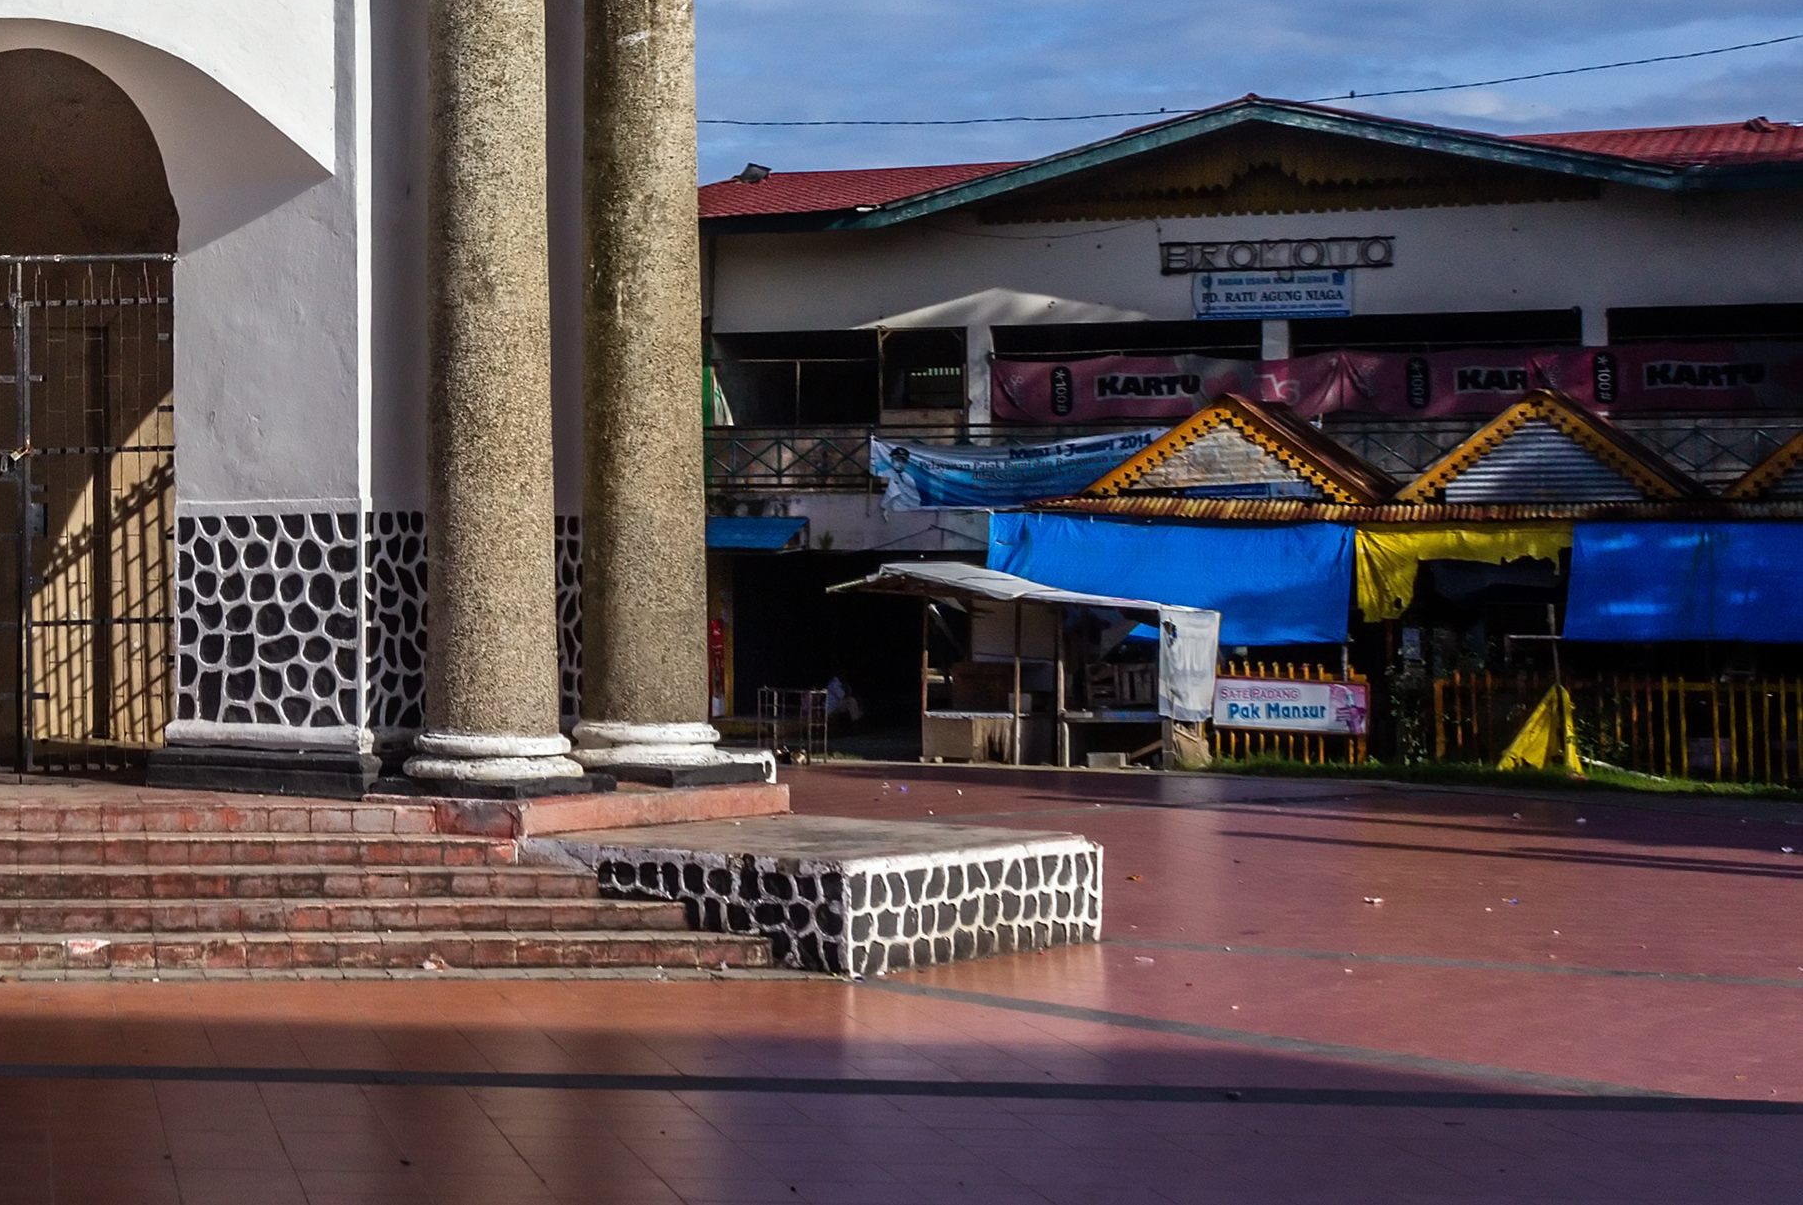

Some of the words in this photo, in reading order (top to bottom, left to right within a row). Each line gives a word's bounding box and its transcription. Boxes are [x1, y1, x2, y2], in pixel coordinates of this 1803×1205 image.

[1225, 291, 1257, 302] RATU
[1261, 290, 1302, 302] AGUNG
[1305, 289, 1344, 301] NIAGA
[1458, 369, 1527, 391] KAR
[1647, 363, 1765, 385] KARTU
[1097, 375, 1200, 397] KARTU
[1221, 688, 1250, 700] SATE
[1252, 688, 1299, 700] PADANG
[1229, 703, 1260, 719] Pak
[1266, 703, 1326, 719] Mansur
